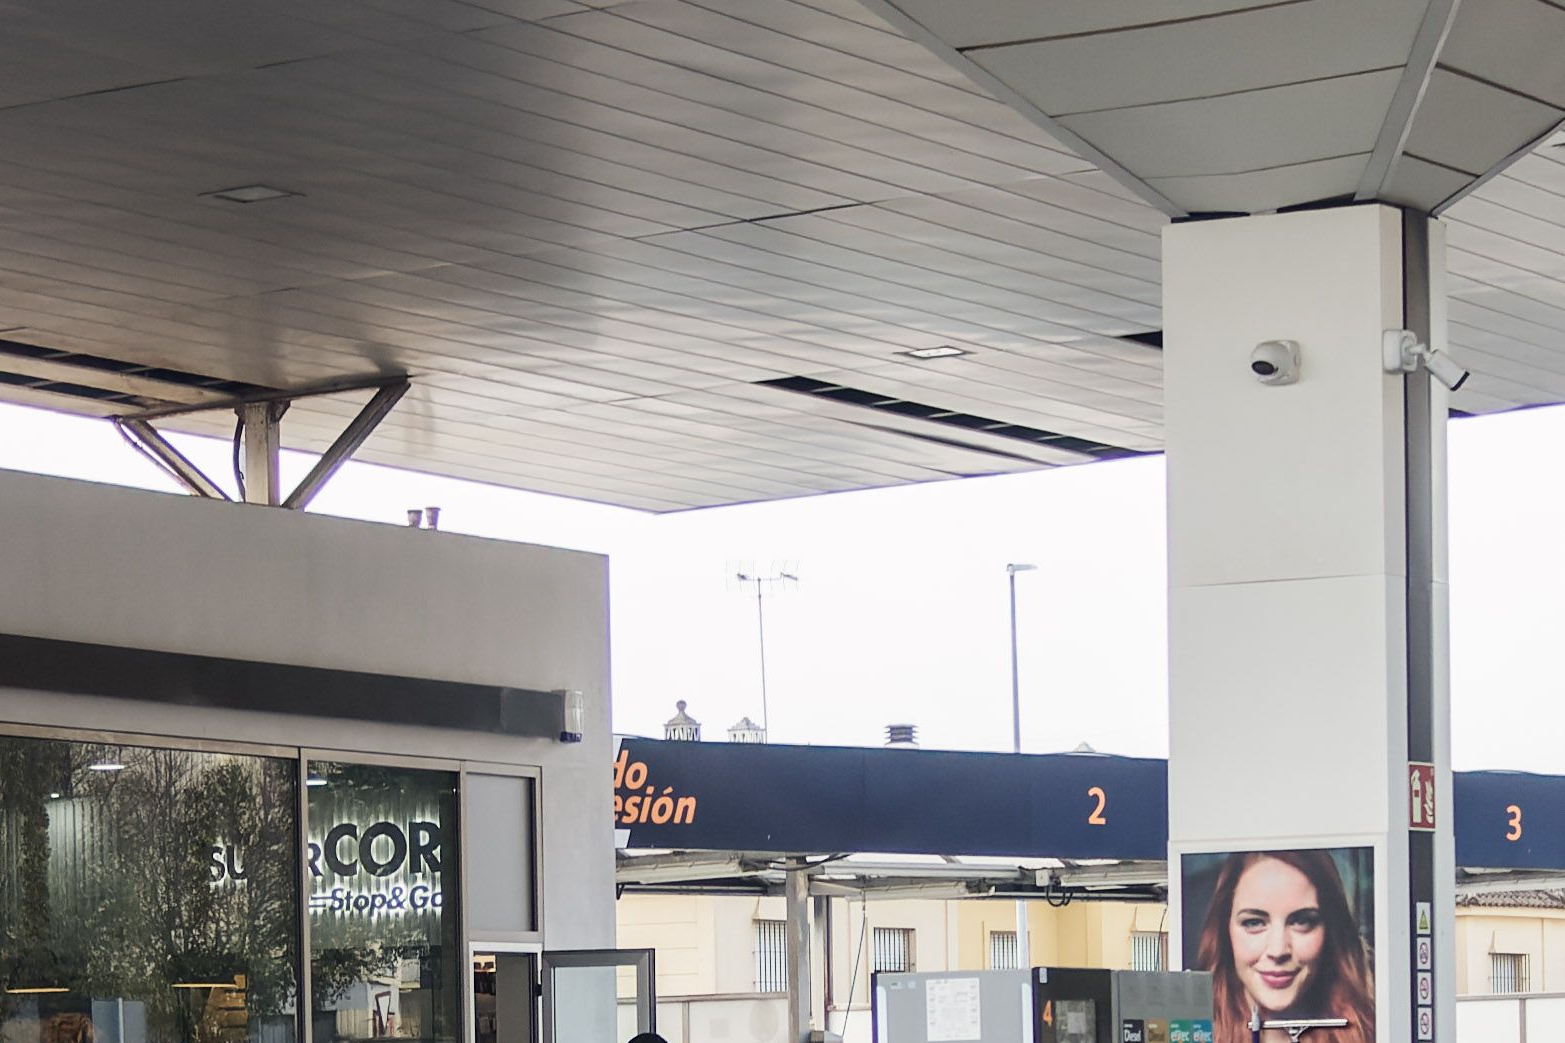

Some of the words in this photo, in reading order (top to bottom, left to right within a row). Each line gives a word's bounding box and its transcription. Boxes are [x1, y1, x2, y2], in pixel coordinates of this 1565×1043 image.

[614, 750, 648, 790] do
[614, 786, 697, 825] esión
[1087, 786, 1106, 825] 2
[1506, 804, 1522, 841] 3
[1042, 1000, 1053, 1027] 4
